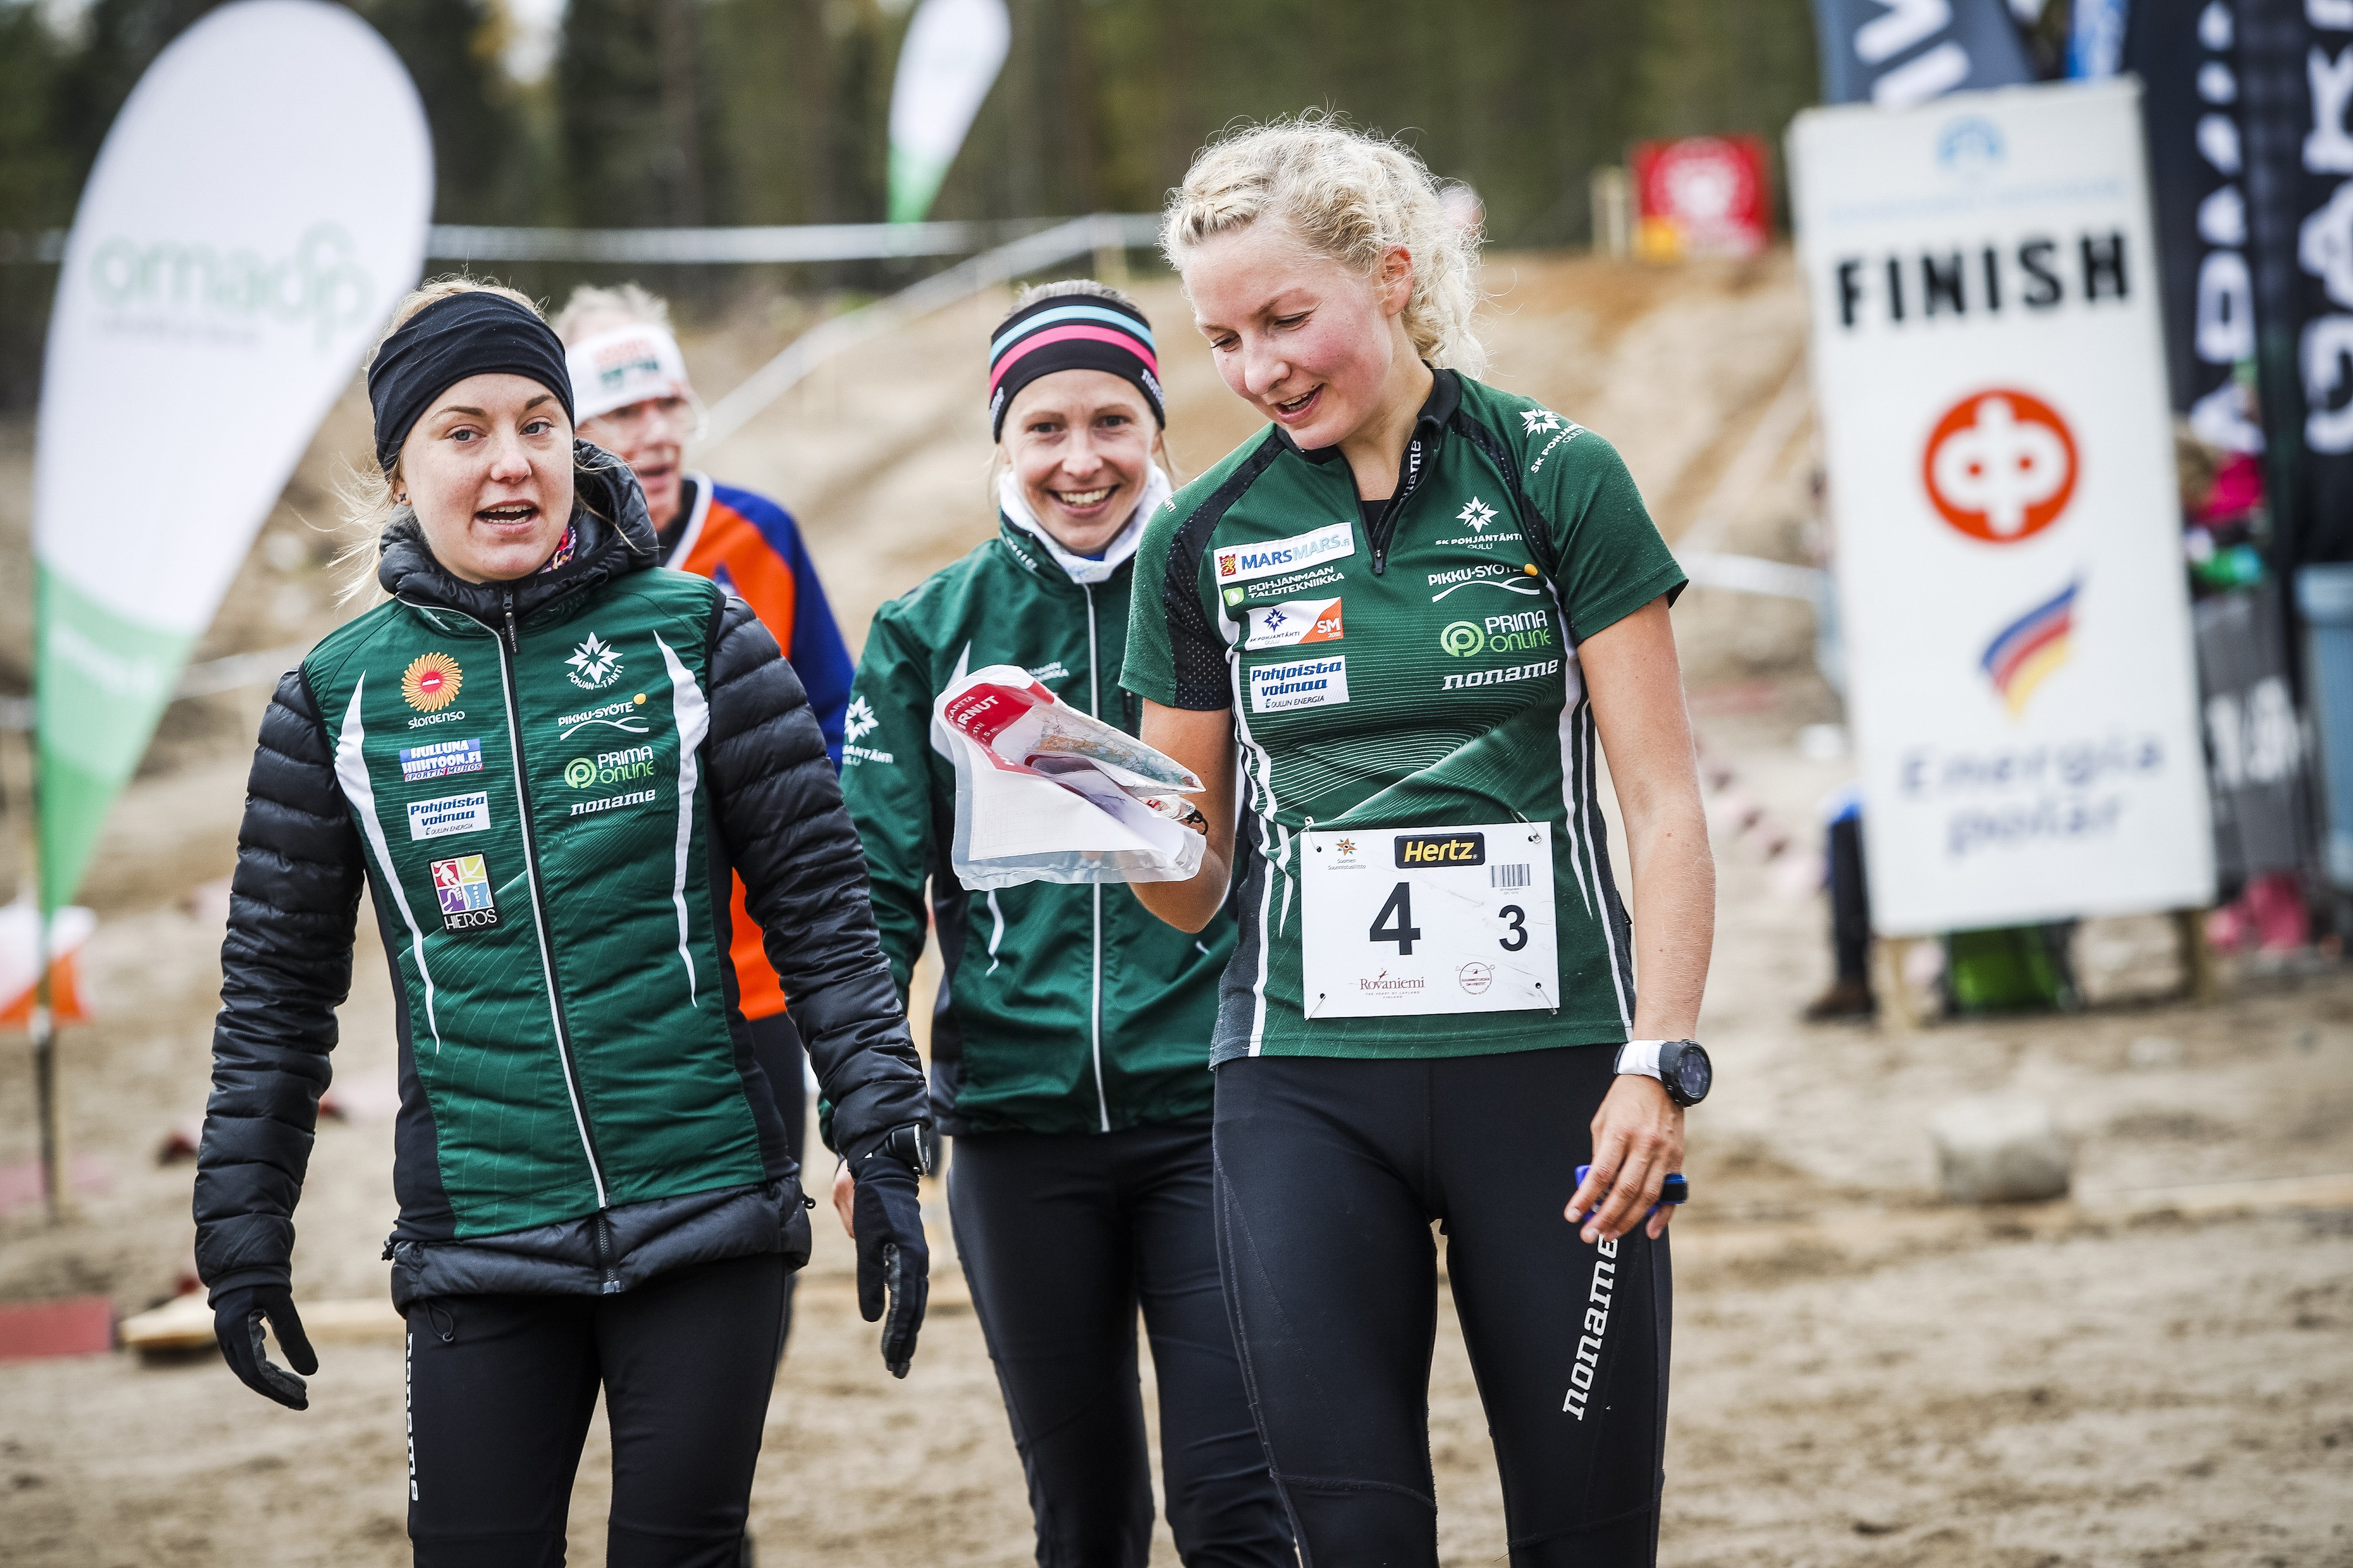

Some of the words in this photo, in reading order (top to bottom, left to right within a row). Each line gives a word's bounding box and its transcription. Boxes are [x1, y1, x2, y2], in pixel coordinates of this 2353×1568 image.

[1837, 228, 2132, 327] FINISH
[1531, 457, 1545, 473] SK
[1451, 532, 1522, 545] POHJANTÄHTI
[1248, 566, 1335, 593] POHJANMAAN
[1248, 572, 1345, 599] TALOTEKNIIKKA
[1317, 618, 1341, 633] SM
[1484, 610, 1548, 635] PRIMA
[1489, 628, 1551, 652] ONLINE
[566, 671, 594, 690] POHJAN
[601, 665, 624, 688] TÄHTI
[1252, 662, 1342, 682] Pohjoista
[1441, 659, 1559, 690] noname
[1262, 679, 1328, 696] voimaa
[1294, 695, 1324, 705] ENERGIA
[408, 710, 465, 729] storaenso
[558, 701, 634, 726] PIKKU-SYÖTE
[410, 739, 469, 759] HULLUNA
[598, 746, 654, 769] PRIMA
[599, 760, 654, 783] ONLINE
[411, 796, 485, 815] Pohjoista
[570, 789, 656, 816] noname
[421, 810, 475, 826] voimaa
[444, 909, 498, 930] HIEROS
[1369, 882, 1421, 956] 4
[1498, 905, 1528, 952] 3
[1359, 976, 1425, 990] Rovaniemi
[1562, 1234, 1618, 1421] noname
